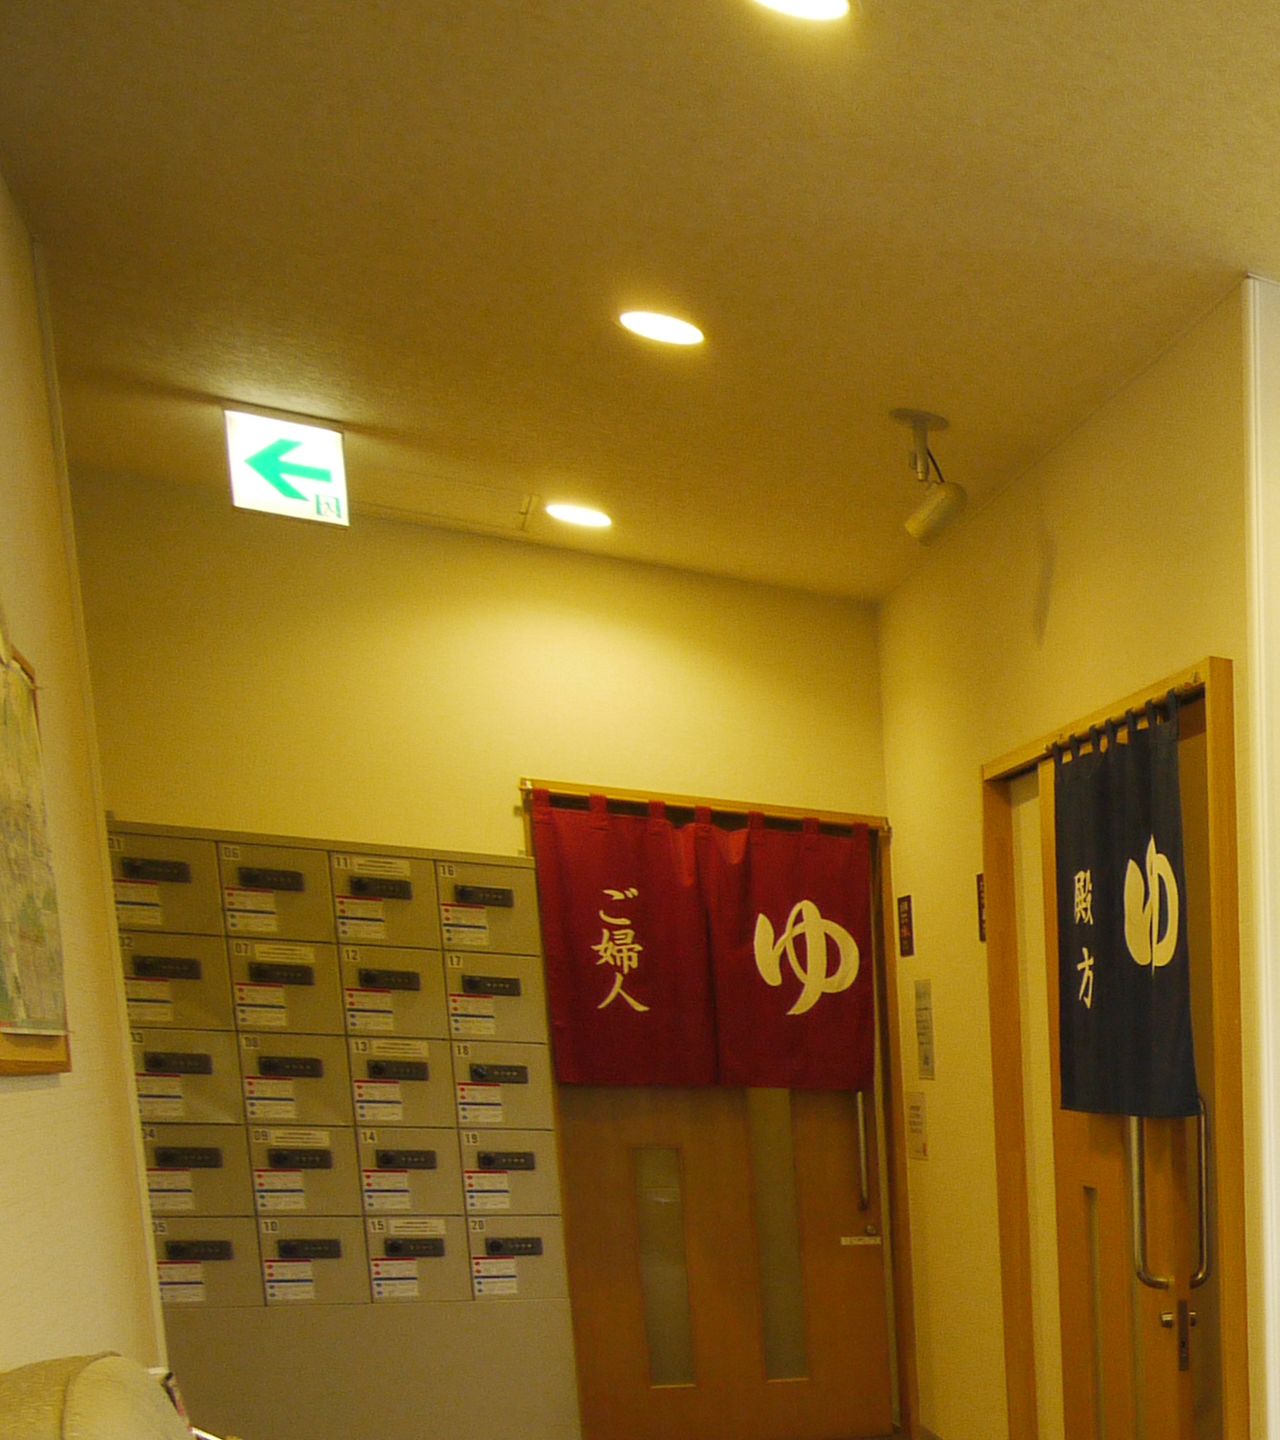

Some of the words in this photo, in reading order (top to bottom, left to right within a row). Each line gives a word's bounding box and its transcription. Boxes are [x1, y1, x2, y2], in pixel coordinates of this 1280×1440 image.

[224, 847, 239, 858] 06
[336, 857, 348, 868] 11
[441, 865, 454, 876] 16
[1124, 834, 1179, 976] ゆ
[1074, 869, 1094, 1009] 殿方
[235, 943, 249, 954] 07
[592, 888, 649, 1011] ご婦人
[345, 949, 358, 960] 12
[754, 900, 860, 1015] ゆ
[449, 956, 461, 966] 17
[355, 1041, 368, 1051] 13
[457, 1045, 469, 1055] 18
[254, 1130, 268, 1140] 09
[362, 1131, 375, 1141] 14
[465, 1133, 478, 1143] 19
[263, 1221, 277, 1231] 10
[371, 1219, 384, 1229] 15
[472, 1219, 484, 1229] 20
